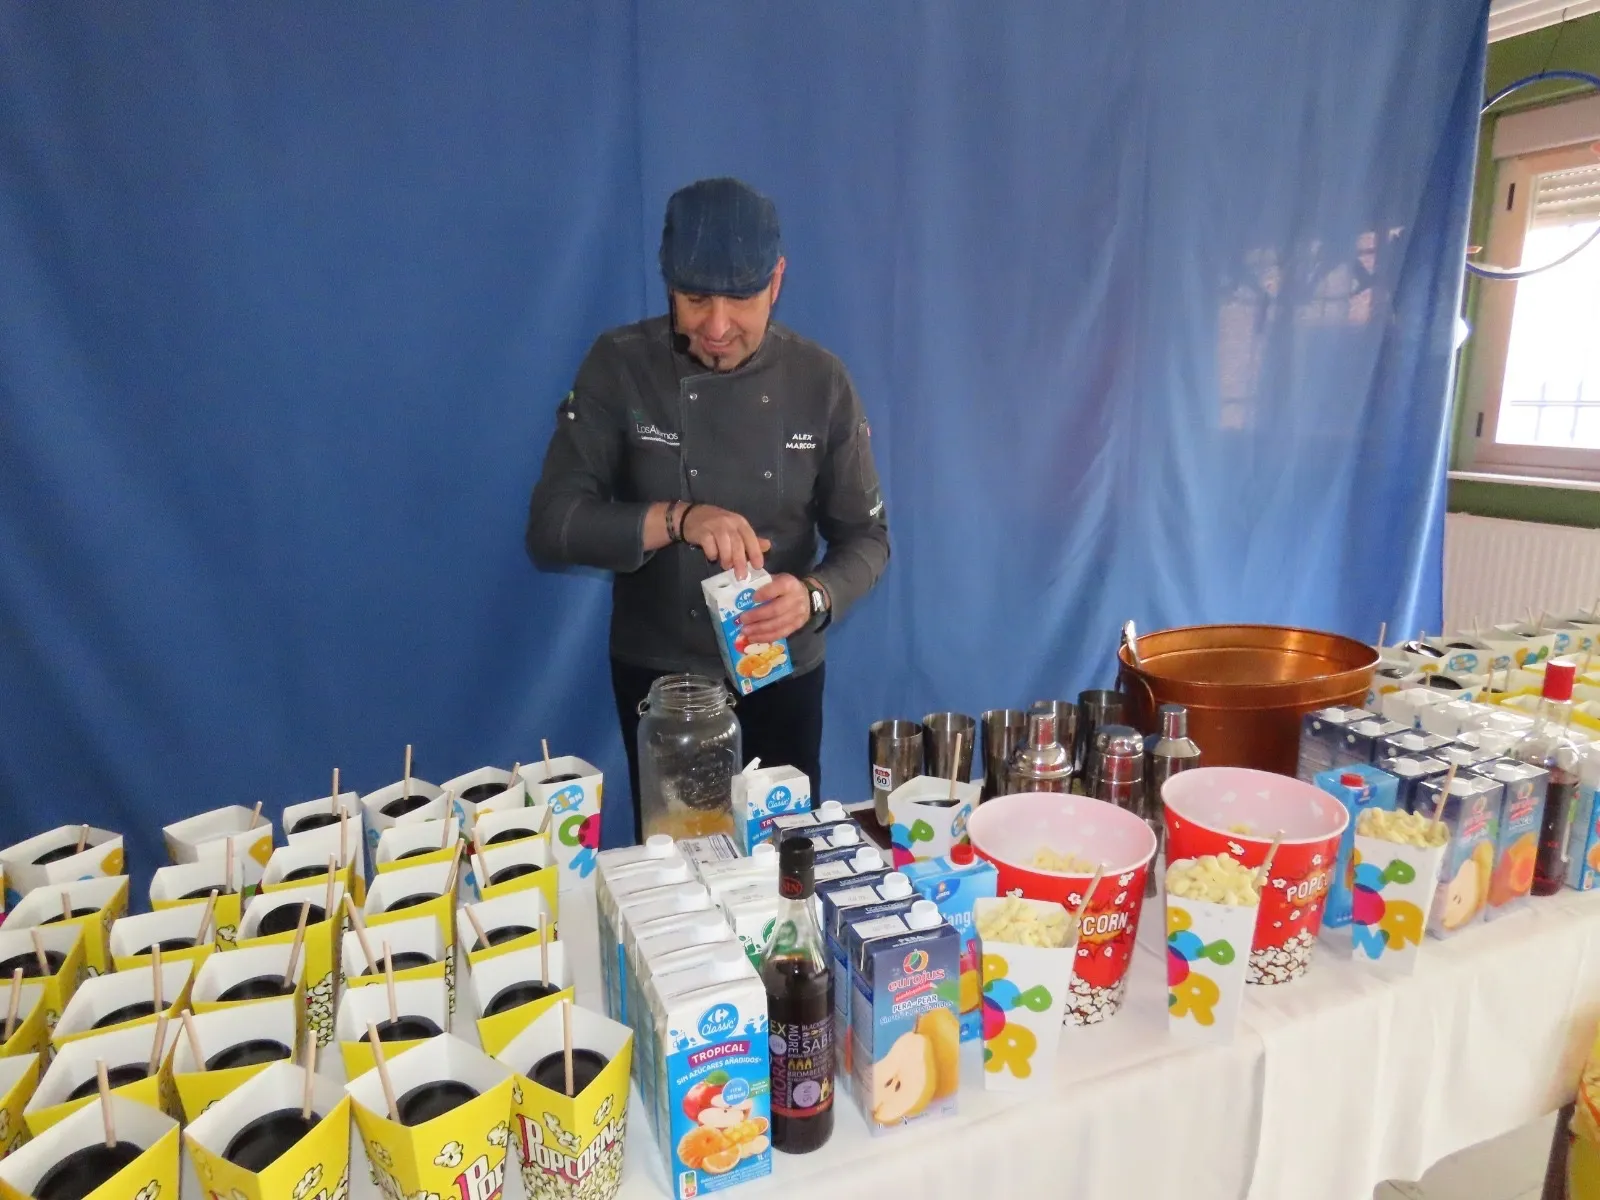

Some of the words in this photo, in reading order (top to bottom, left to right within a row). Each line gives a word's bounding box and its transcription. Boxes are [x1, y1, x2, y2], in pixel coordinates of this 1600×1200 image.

[792, 433, 813, 441] ALEX
[876, 776, 887, 785] 60
[1077, 911, 1129, 936] CORN
[887, 968, 945, 992] eurojus
[691, 1045, 745, 1064] TROPICAL
[676, 1074, 689, 1086] SIN
[689, 1061, 724, 1079] AZÚCARES
[515, 1113, 617, 1178] POPCORN
